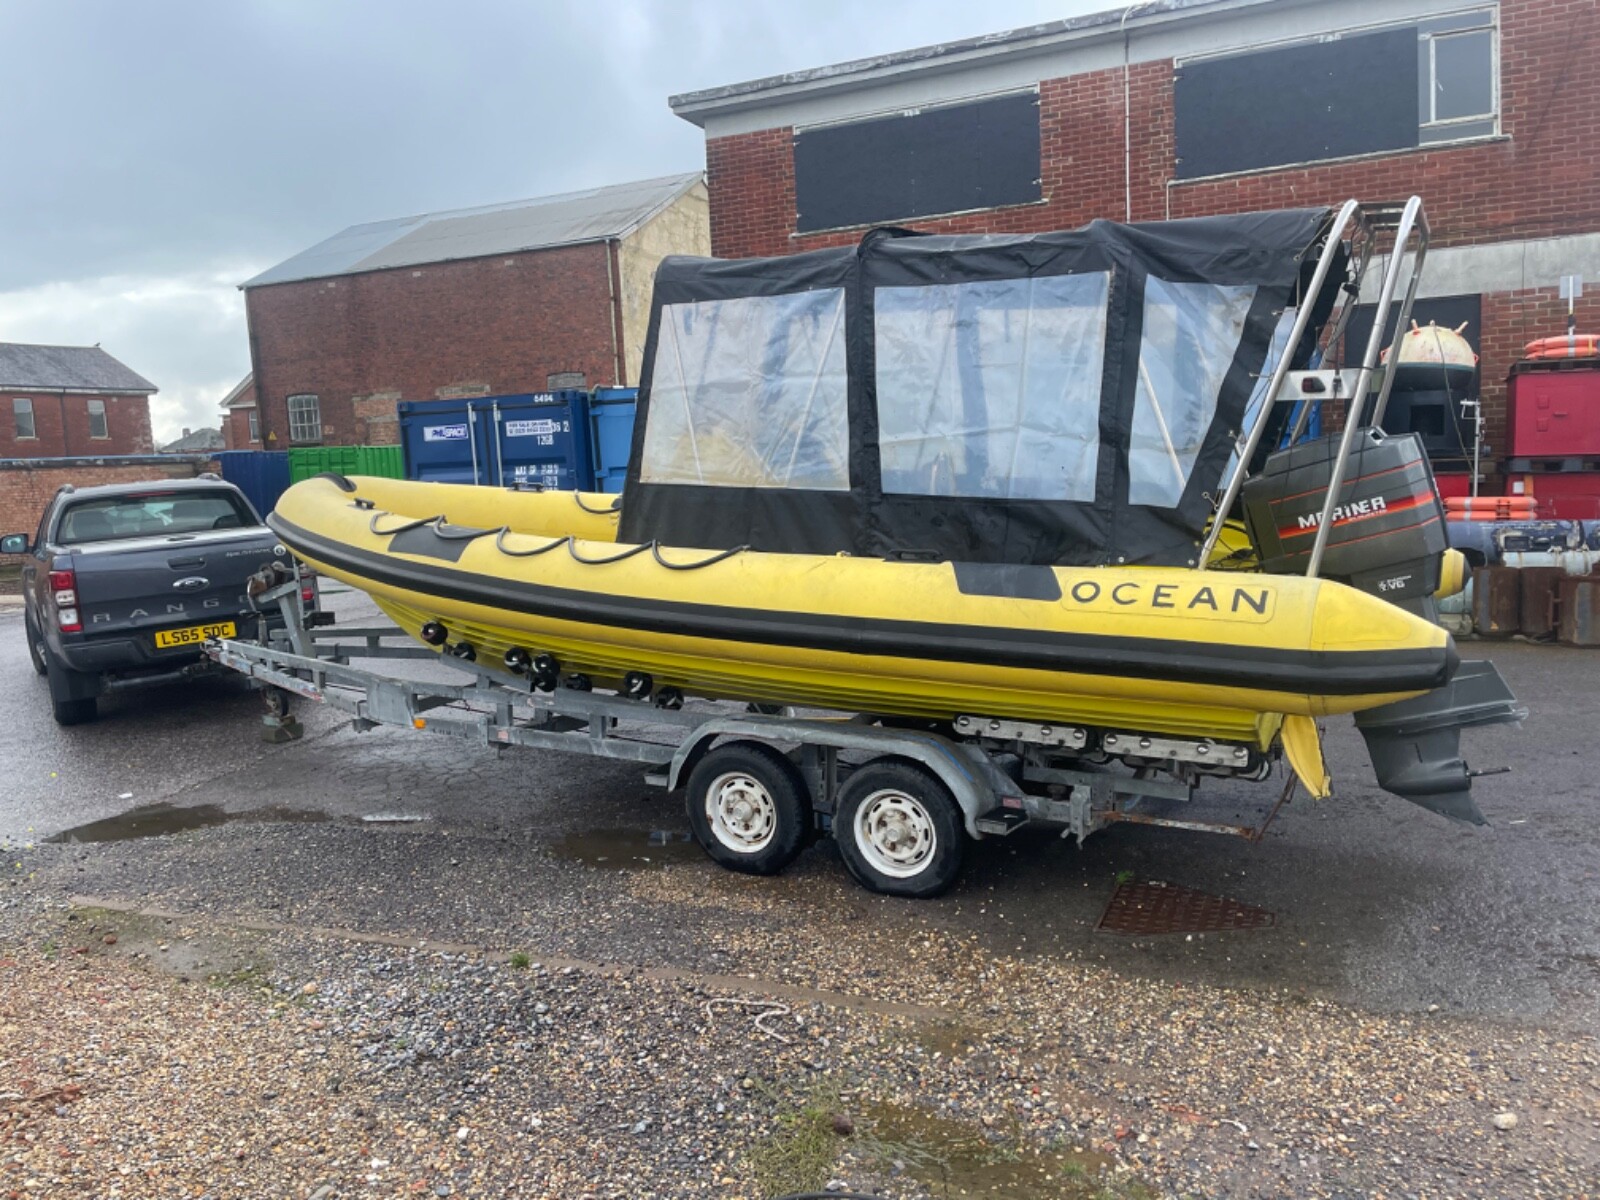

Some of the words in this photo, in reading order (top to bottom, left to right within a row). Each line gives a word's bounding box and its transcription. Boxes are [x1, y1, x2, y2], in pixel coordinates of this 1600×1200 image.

[1071, 580, 1269, 615] OCEAN
[161, 628, 200, 646] LS65
[202, 624, 230, 640] SDC
